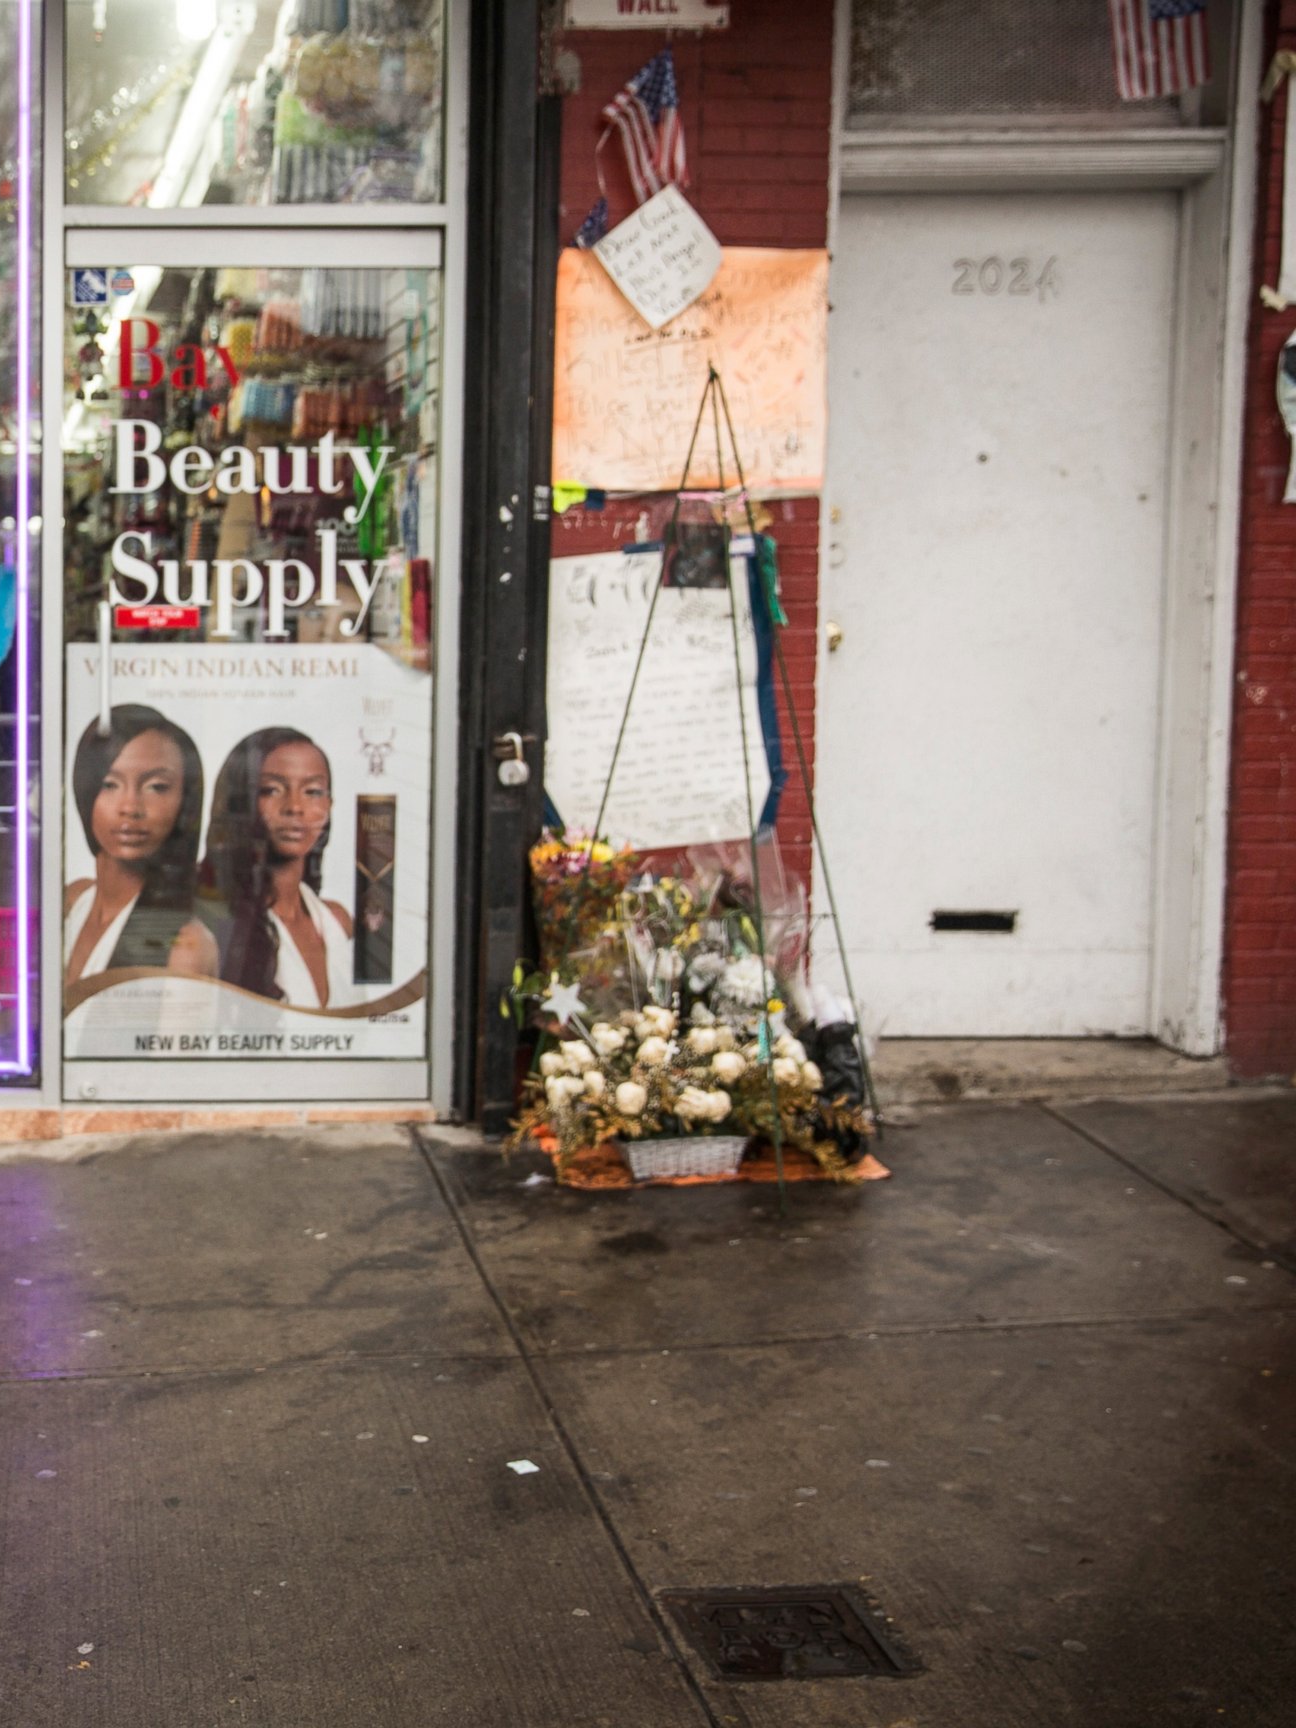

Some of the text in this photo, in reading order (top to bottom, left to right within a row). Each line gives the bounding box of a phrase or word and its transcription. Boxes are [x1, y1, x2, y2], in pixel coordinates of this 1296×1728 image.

[617, 0, 678, 15] WALL
[112, 317, 249, 420] Bay
[108, 418, 395, 525] Beauty
[109, 531, 392, 637] Supply
[83, 656, 360, 678] VRGIN INDIAN REMI
[135, 1034, 354, 1051] NEW BAY BEAUTY SUPPLY
